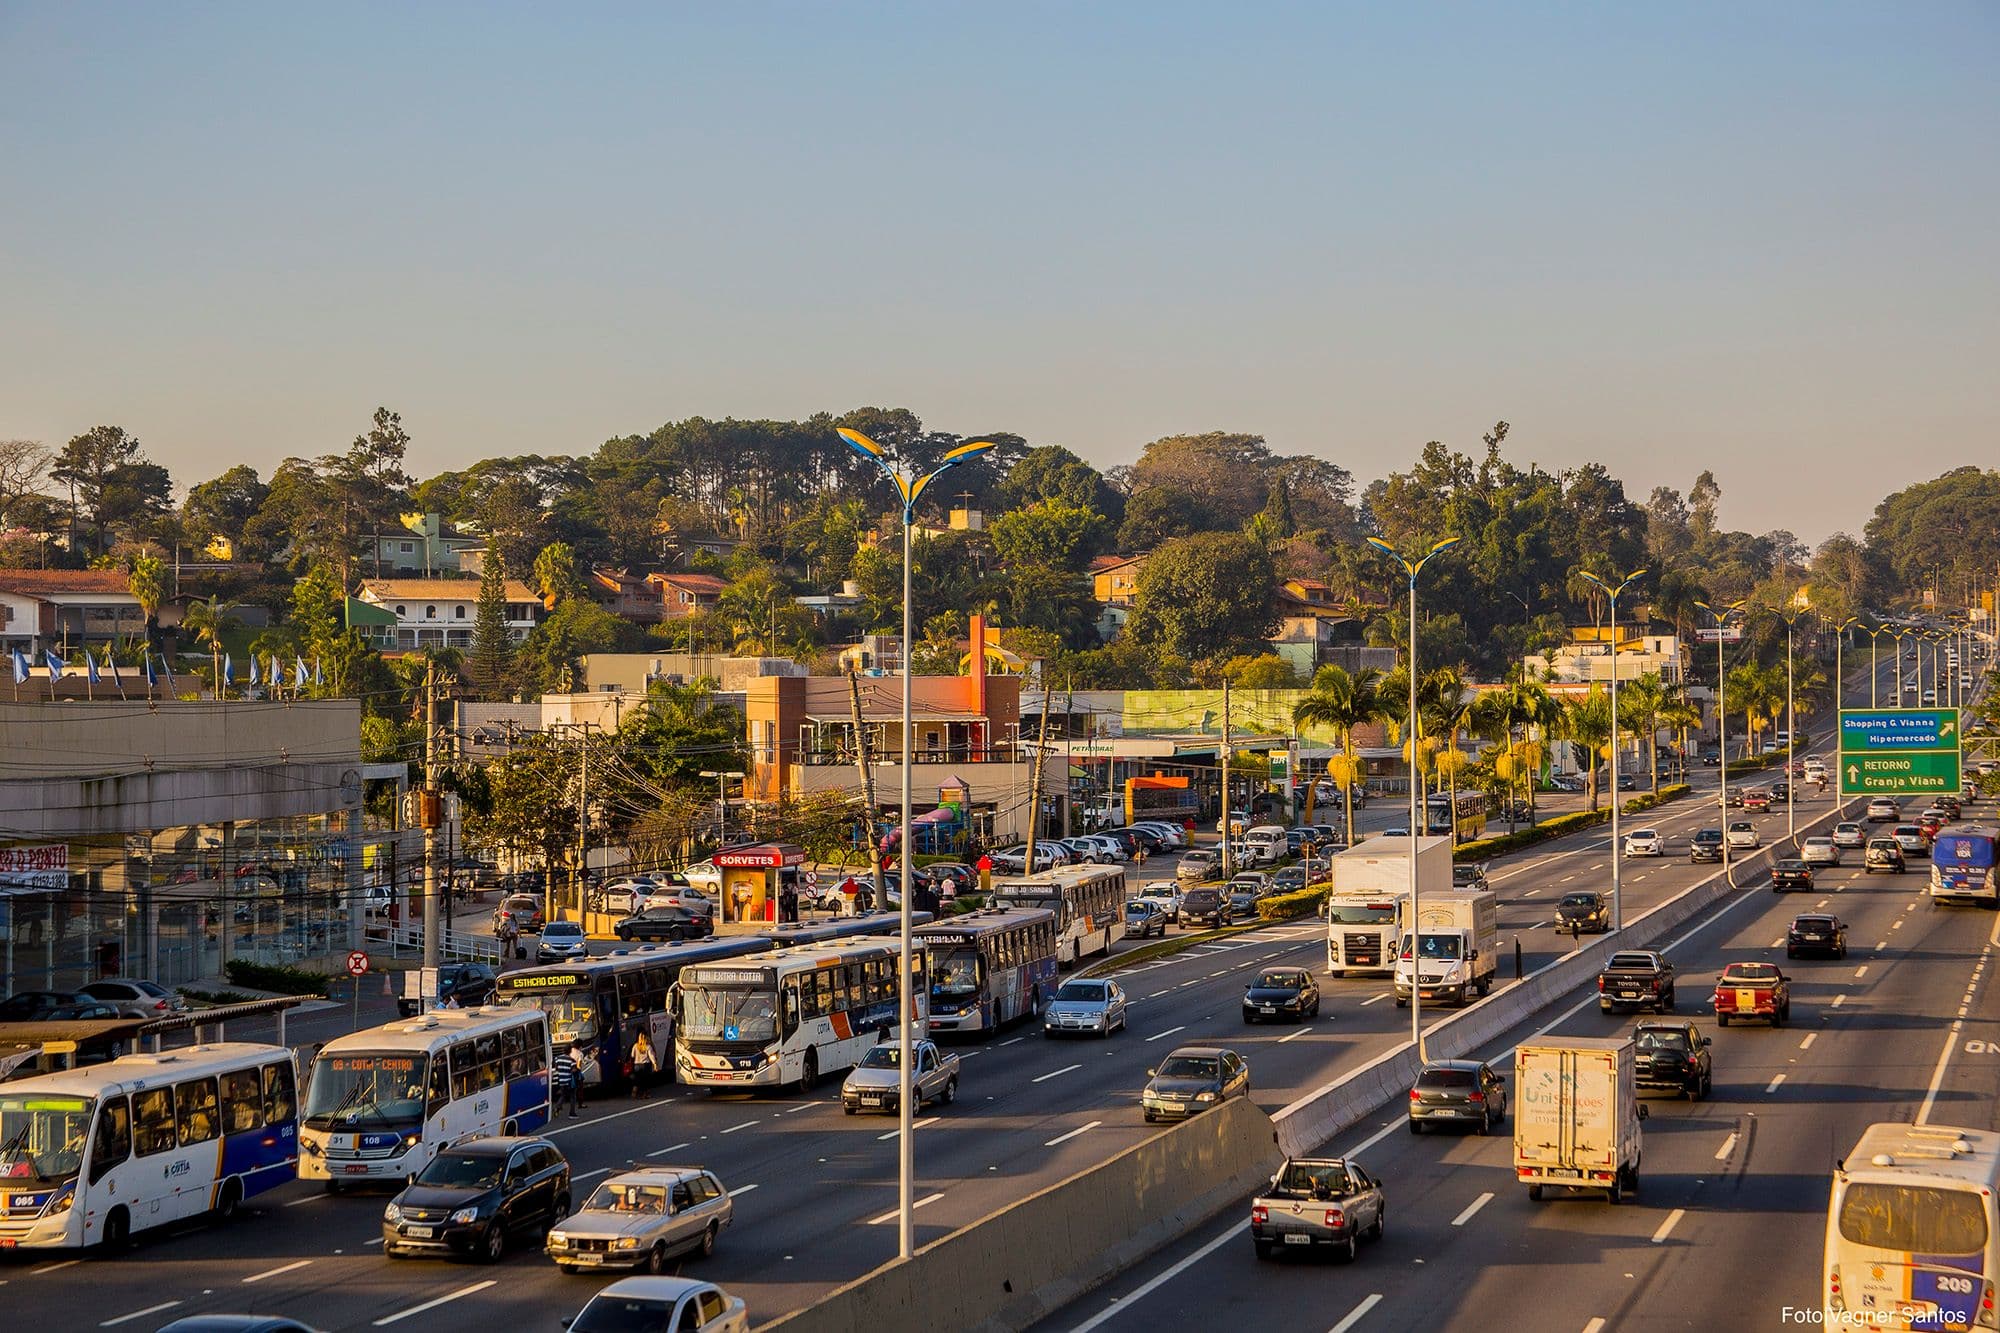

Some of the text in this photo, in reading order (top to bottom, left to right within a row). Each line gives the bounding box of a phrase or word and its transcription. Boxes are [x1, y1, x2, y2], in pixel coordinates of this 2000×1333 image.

[1844, 720, 1887, 728] Shopping
[1900, 719, 1935, 727] Vianna
[1870, 734, 1936, 743] Hipermercado
[1272, 756, 1288, 765] BR
[1864, 760, 1911, 770] RETORNO
[1864, 777, 1945, 788] Granja Viana
[29, 845, 66, 870] PONTO
[720, 855, 775, 865] SORVETES
[547, 975, 576, 986] CENTRO
[714, 971, 736, 980] EXTRA
[739, 971, 761, 980] COTIA
[382, 1060, 412, 1070] CENTRO
[281, 1125, 294, 1138] 085
[333, 1136, 380, 1144] 31 108
[15, 1195, 34, 1206] 085
[1936, 1275, 1973, 1294] 209
